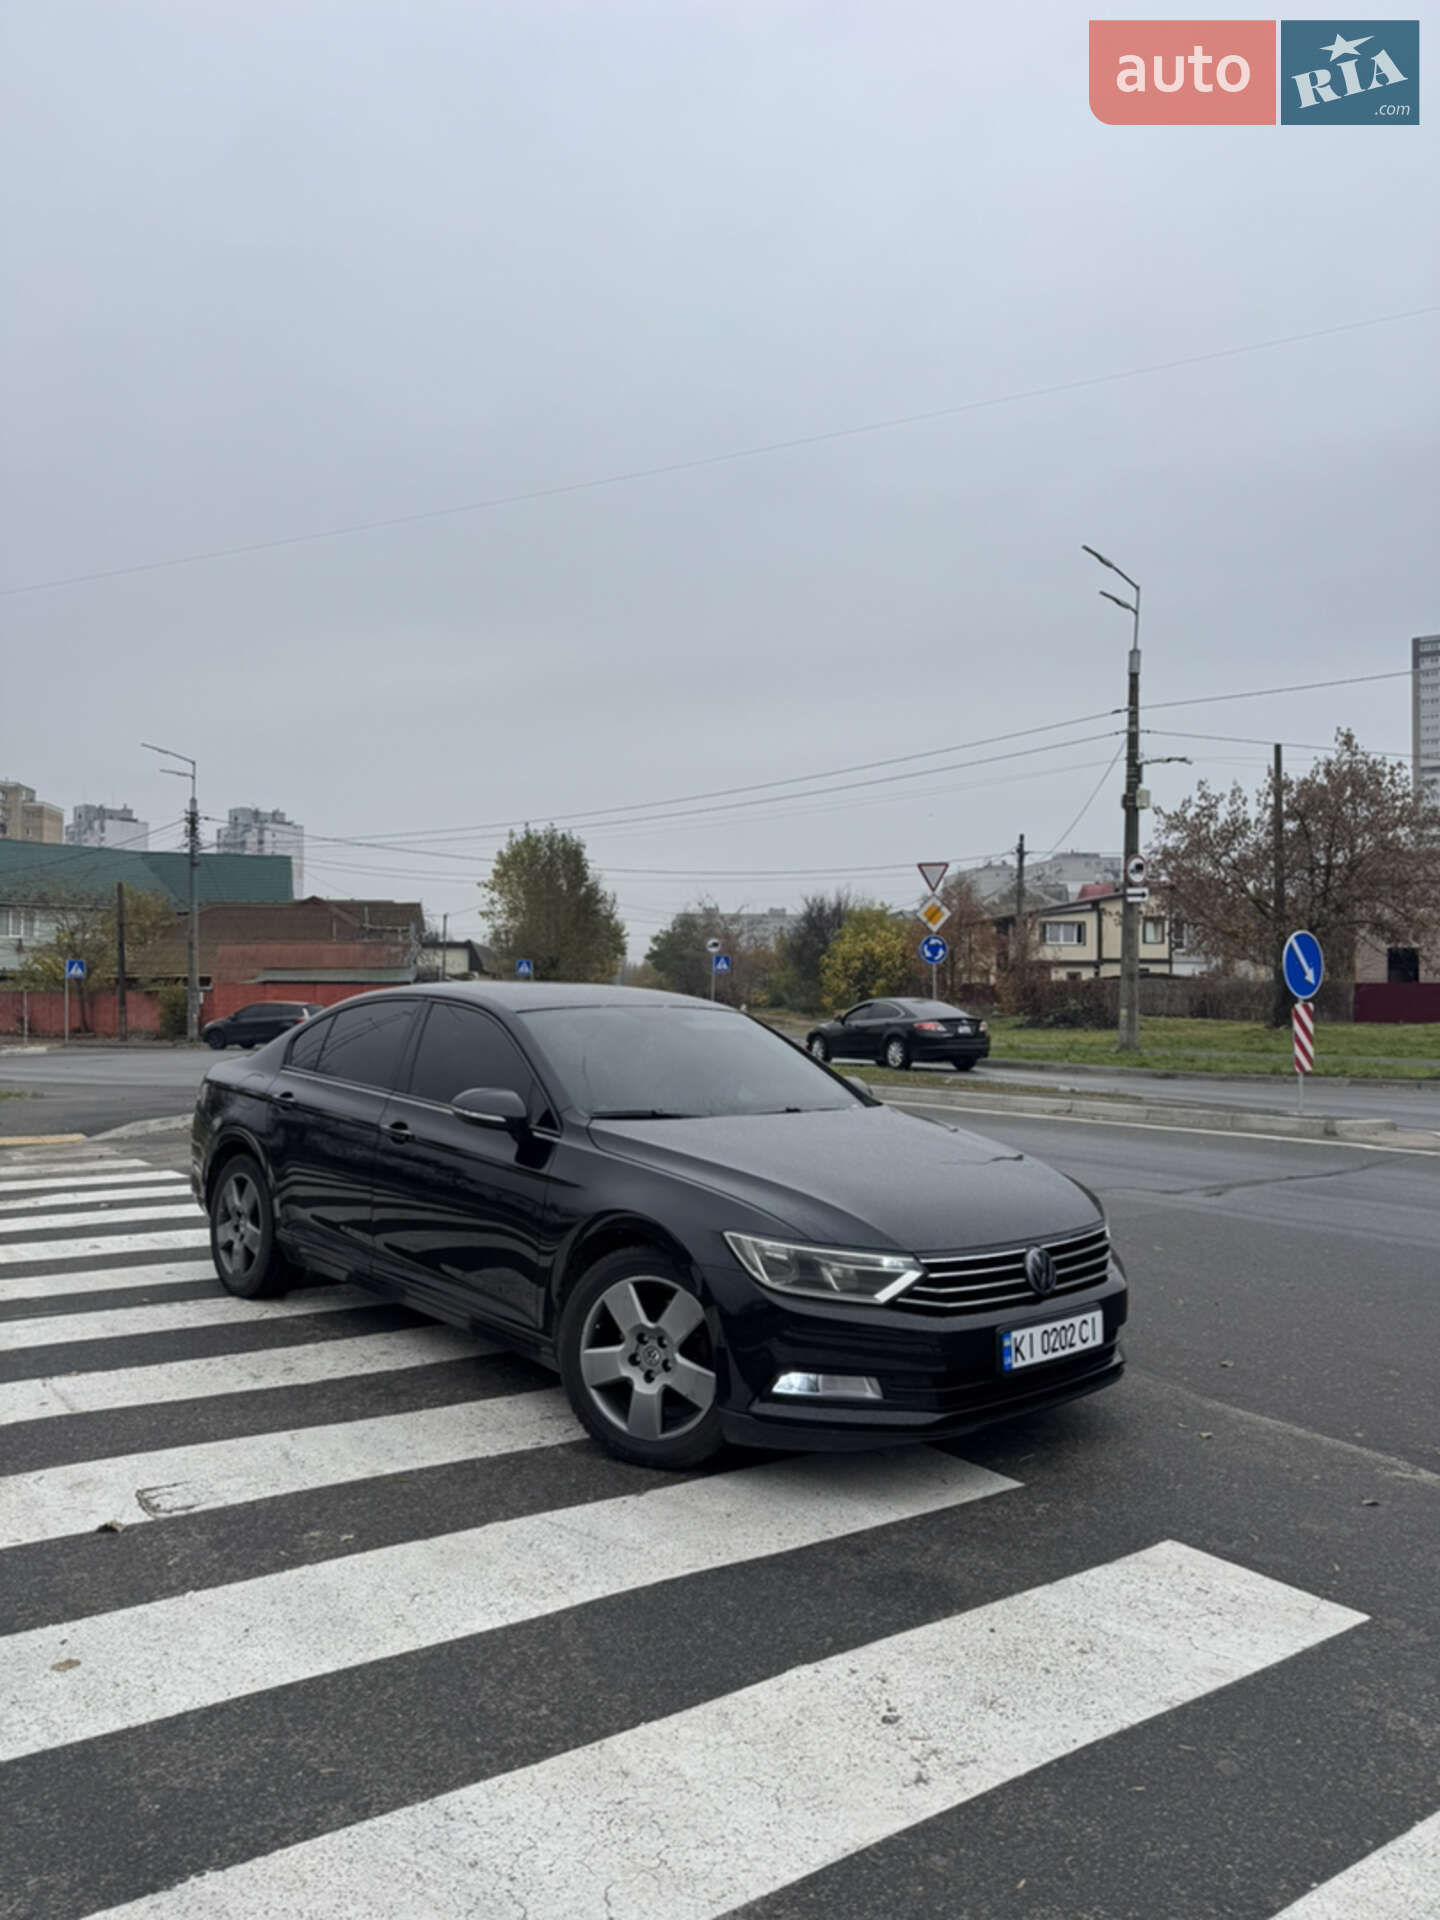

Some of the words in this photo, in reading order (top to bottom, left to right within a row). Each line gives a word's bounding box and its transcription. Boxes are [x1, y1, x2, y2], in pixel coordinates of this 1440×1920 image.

[1013, 1332, 1035, 1363] KI
[1041, 1322, 1077, 1356] 0202
[1078, 1316, 1097, 1345] CI
